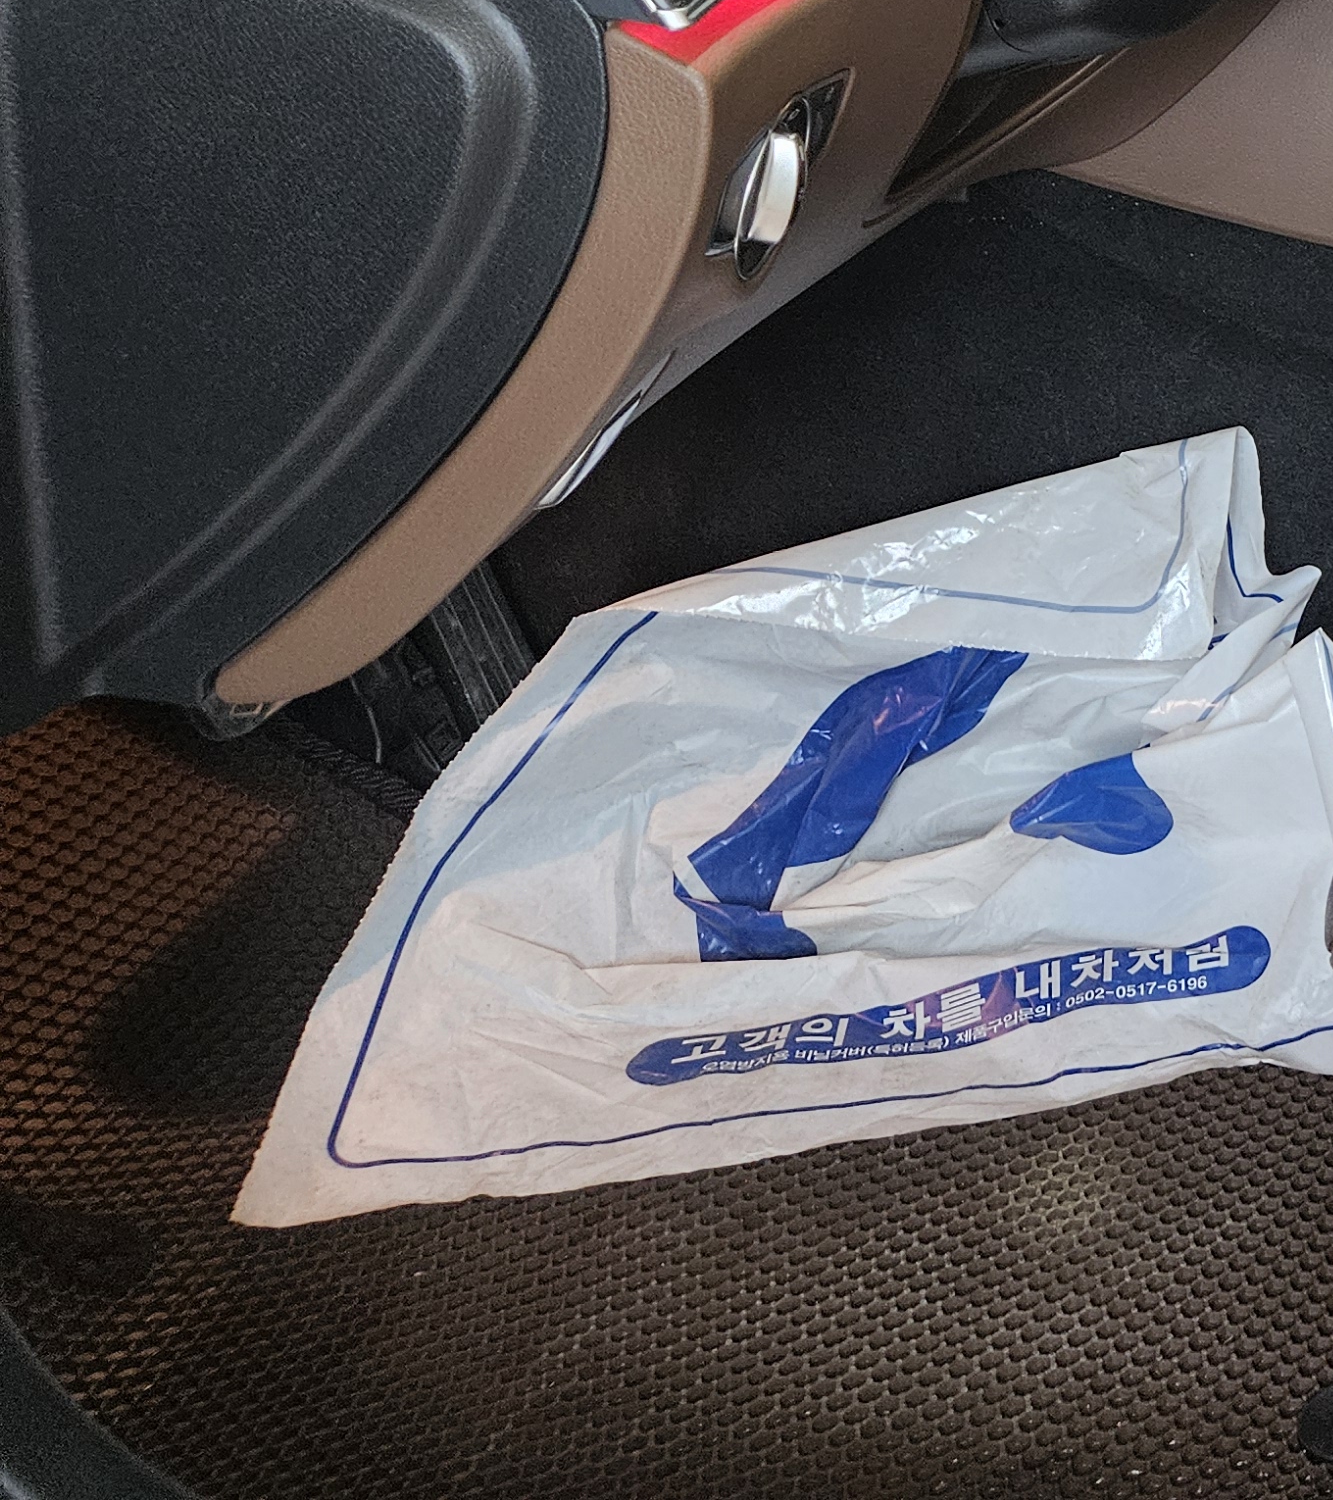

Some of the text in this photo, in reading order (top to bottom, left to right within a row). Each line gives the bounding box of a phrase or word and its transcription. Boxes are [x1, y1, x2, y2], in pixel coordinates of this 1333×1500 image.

[1065, 975, 1207, 1009] 0502-0517-6196
[671, 1016, 850, 1064] 고객의
[880, 983, 985, 1040] 차를
